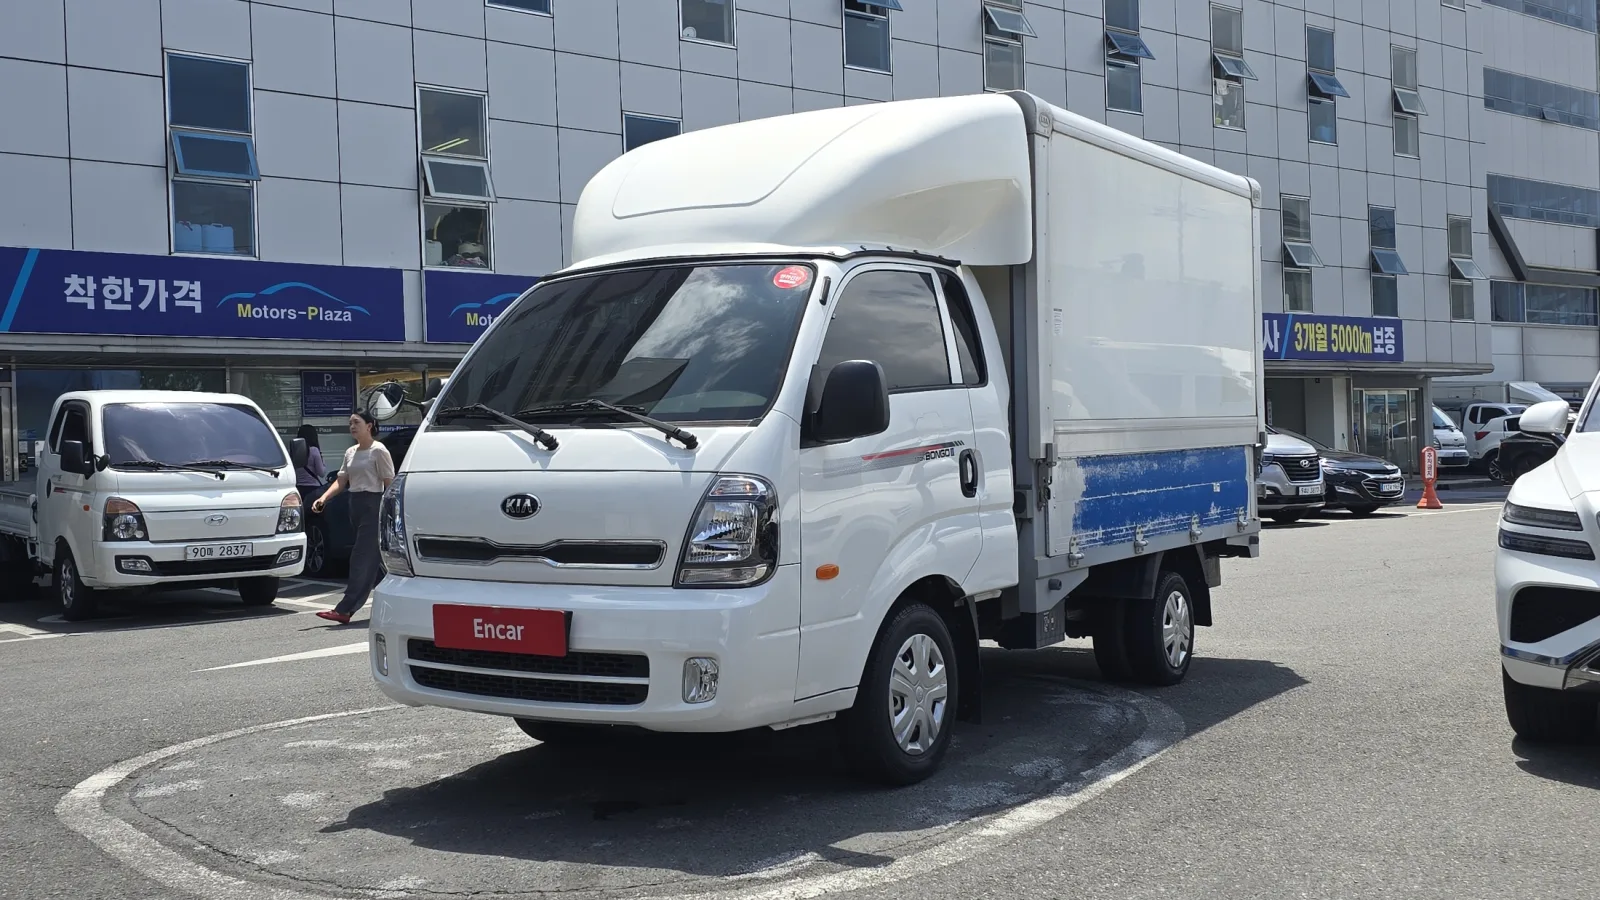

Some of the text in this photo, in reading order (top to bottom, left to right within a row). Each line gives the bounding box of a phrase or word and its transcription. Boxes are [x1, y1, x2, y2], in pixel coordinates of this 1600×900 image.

[64, 274, 202, 313] 착한가격
[237, 303, 352, 322] Motors-Plaza
[1263, 320, 1280, 353] 사
[1294, 322, 1328, 352] 3개월
[925, 449, 950, 461] BONGO
[505, 498, 533, 514] KIA
[219, 544, 247, 557] 2837
[473, 618, 525, 641] Encar
